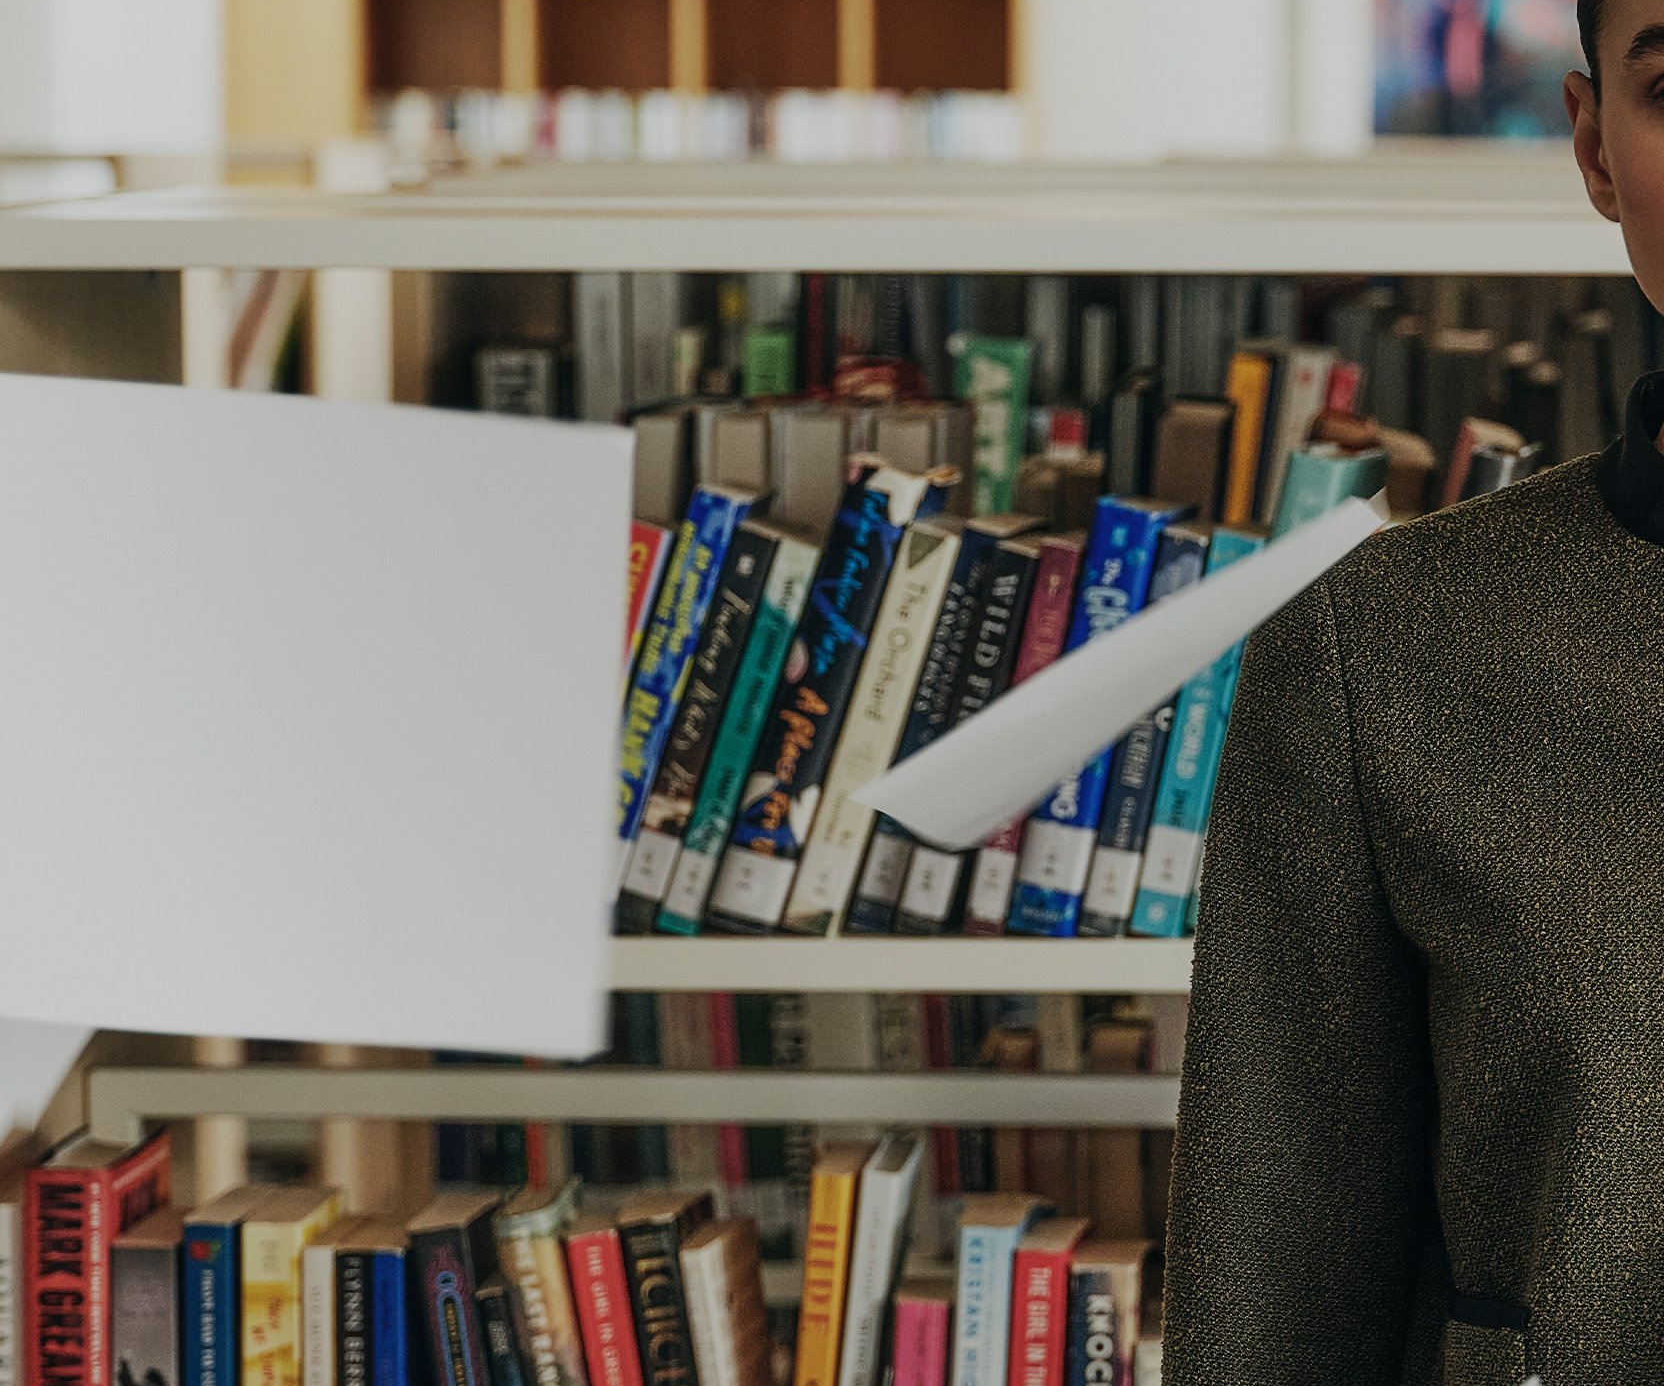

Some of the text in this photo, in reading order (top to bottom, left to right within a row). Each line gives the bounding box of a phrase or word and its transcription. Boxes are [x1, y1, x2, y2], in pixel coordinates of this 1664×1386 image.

[862, 580, 927, 725] The Orchard
[961, 572, 1020, 721] WILD FI
[36, 1182, 86, 1279] MARK
[585, 1244, 604, 1277] THE
[343, 1257, 365, 1332] FLYNN
[591, 1281, 613, 1320] GIRL
[1027, 1267, 1053, 1297] THE
[517, 1273, 548, 1331] LAST
[1026, 1300, 1050, 1339] GIRL
[598, 1324, 615, 1344] IN
[1025, 1343, 1048, 1363] IN
